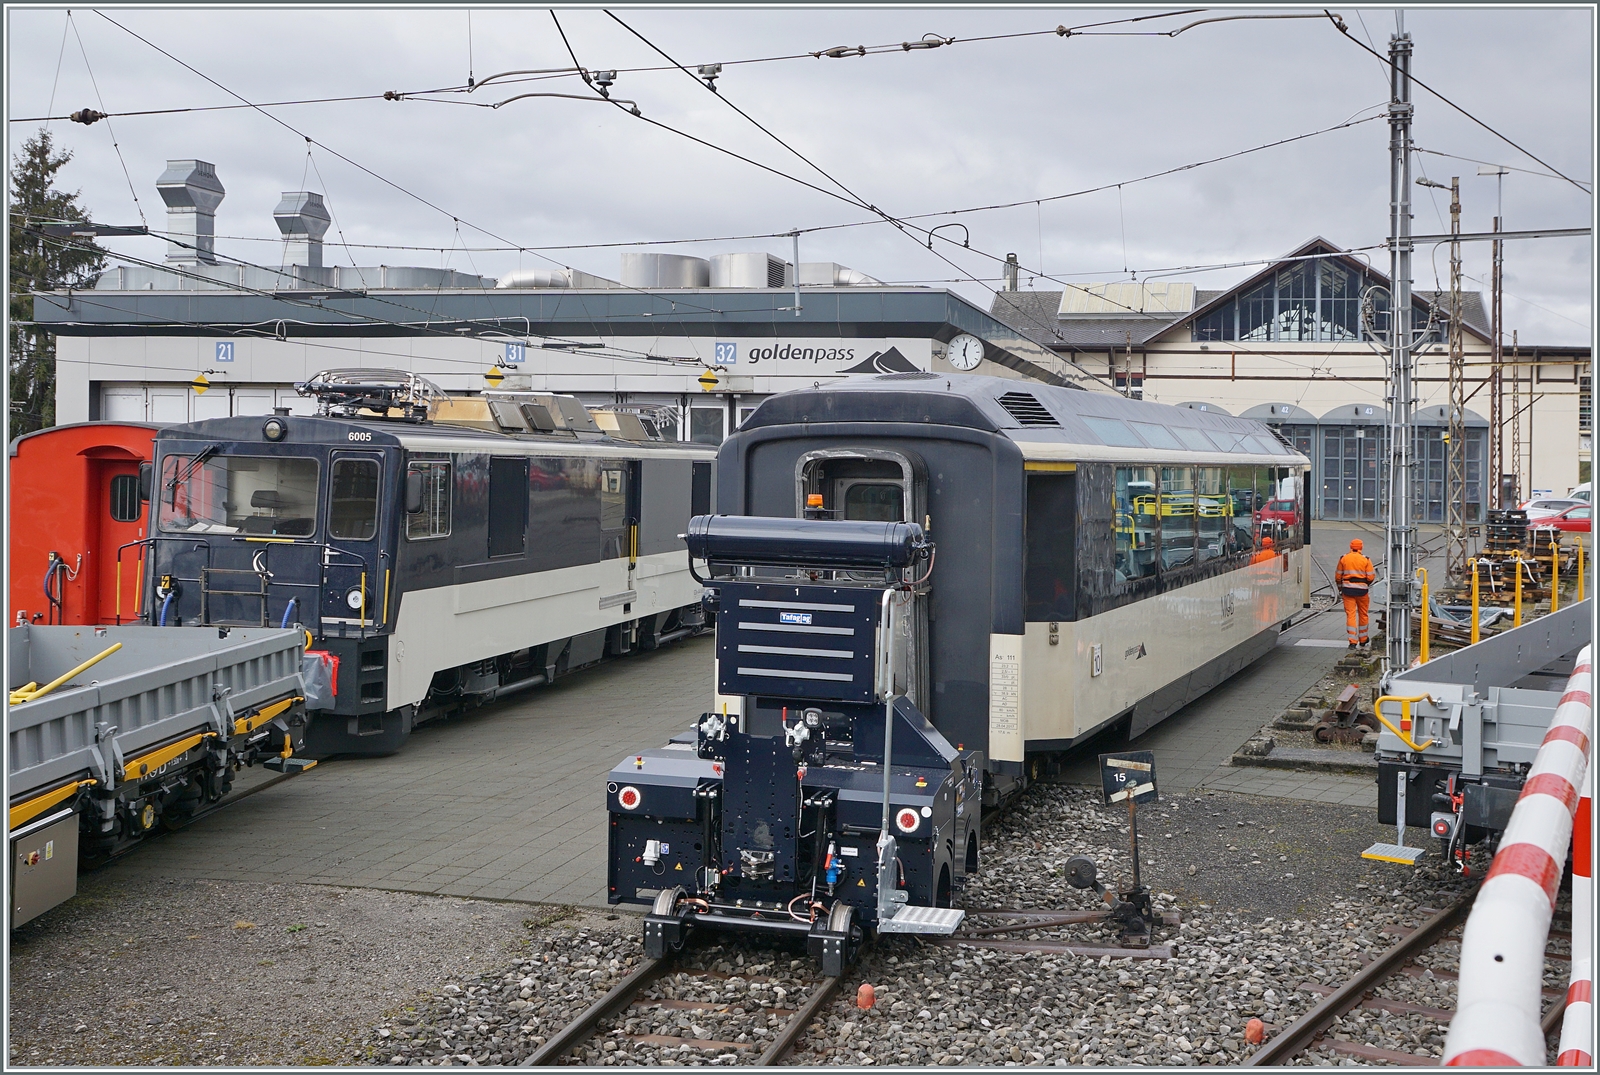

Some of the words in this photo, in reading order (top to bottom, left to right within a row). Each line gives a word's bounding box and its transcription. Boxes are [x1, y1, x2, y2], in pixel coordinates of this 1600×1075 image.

[218, 343, 232, 361] 21
[508, 344, 522, 361] 31
[716, 344, 735, 362] 32
[748, 343, 855, 364] goldenpass
[1281, 406, 1289, 414] 42
[1364, 407, 1374, 415] 43
[348, 431, 372, 442] 6005
[794, 587, 800, 596] 1
[782, 613, 801, 623] Tafag
[820, 730, 826, 740] 1
[1113, 772, 1127, 782] 15
